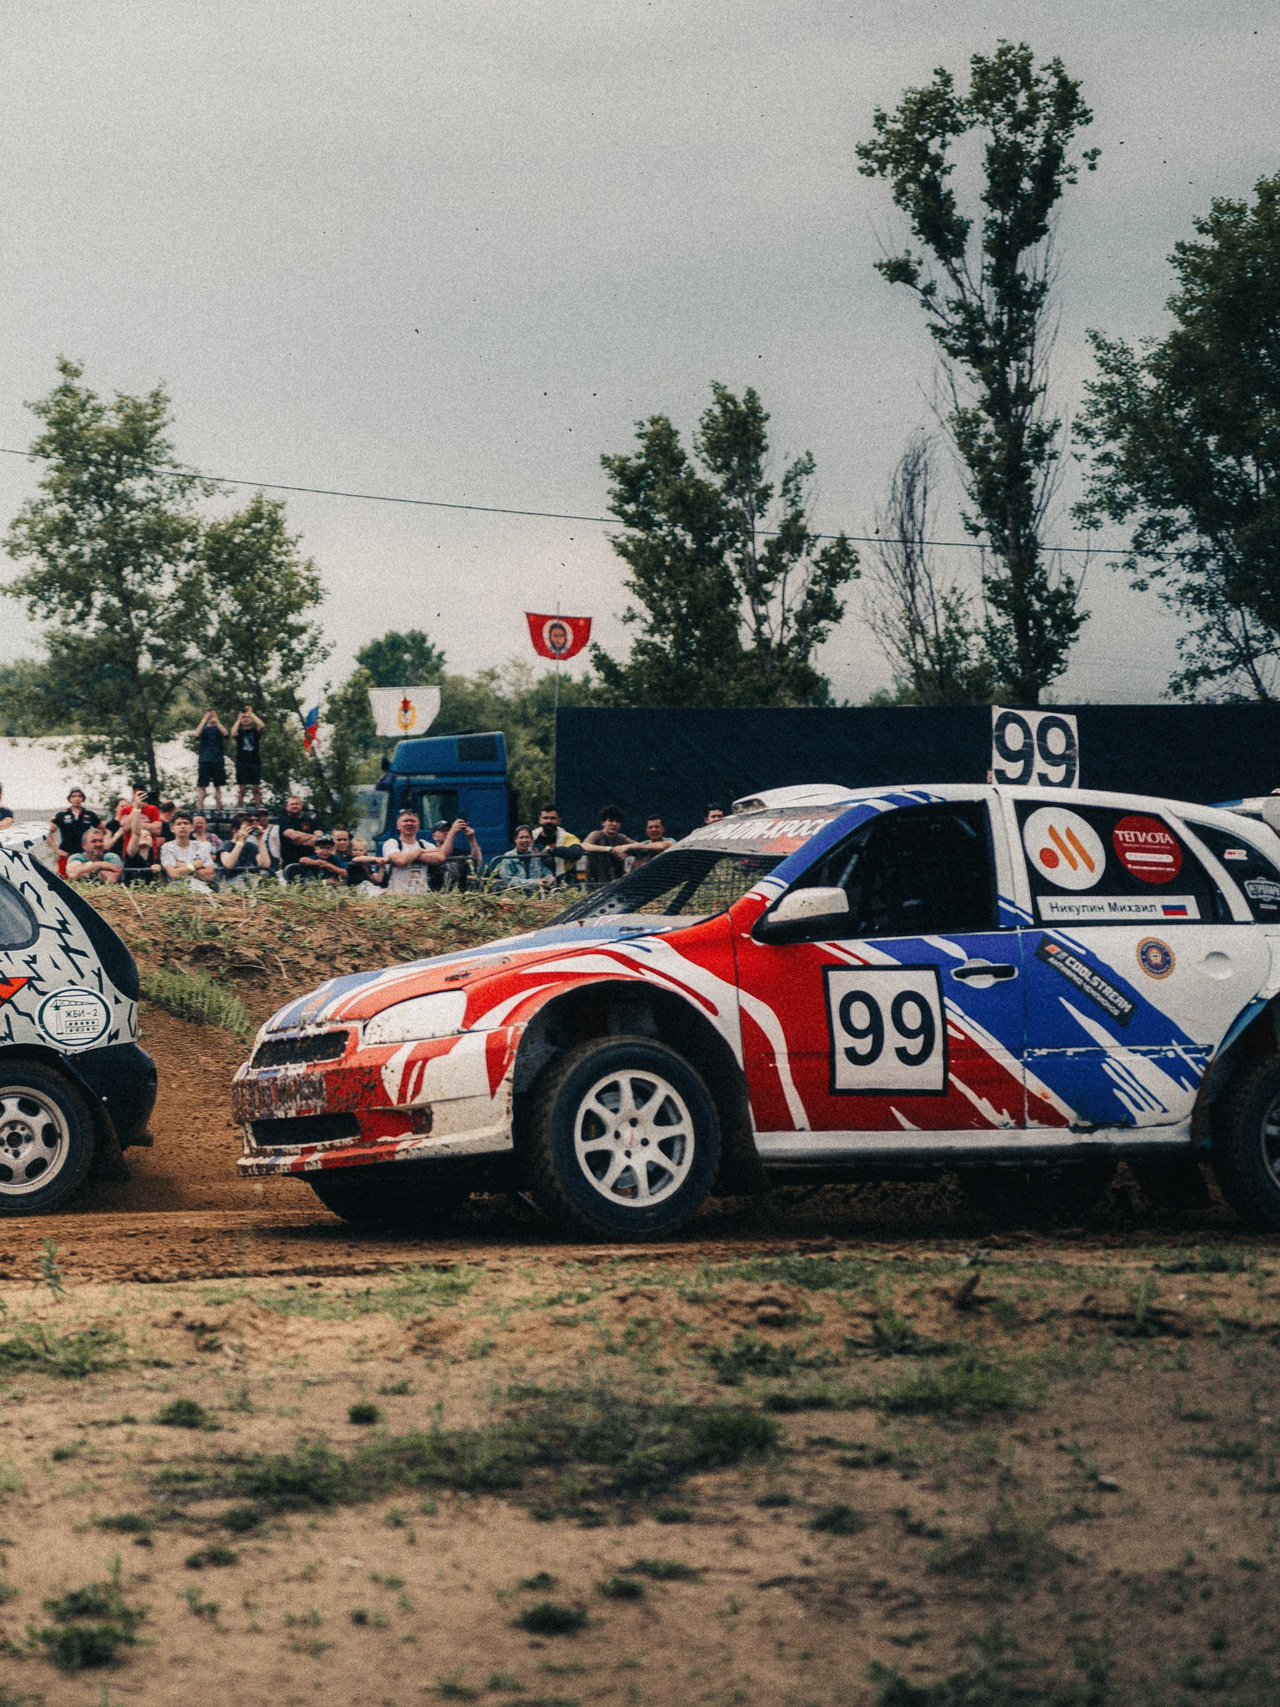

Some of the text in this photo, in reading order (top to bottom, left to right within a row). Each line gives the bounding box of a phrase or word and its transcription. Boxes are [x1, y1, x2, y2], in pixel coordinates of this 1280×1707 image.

[993, 711, 1077, 786] 99
[1114, 829, 1174, 844] ТЕПЛОТА
[1049, 902, 1157, 915] Никулин Михаил
[1064, 956, 1133, 1013] COOLSTREAM
[838, 990, 937, 1067] 99
